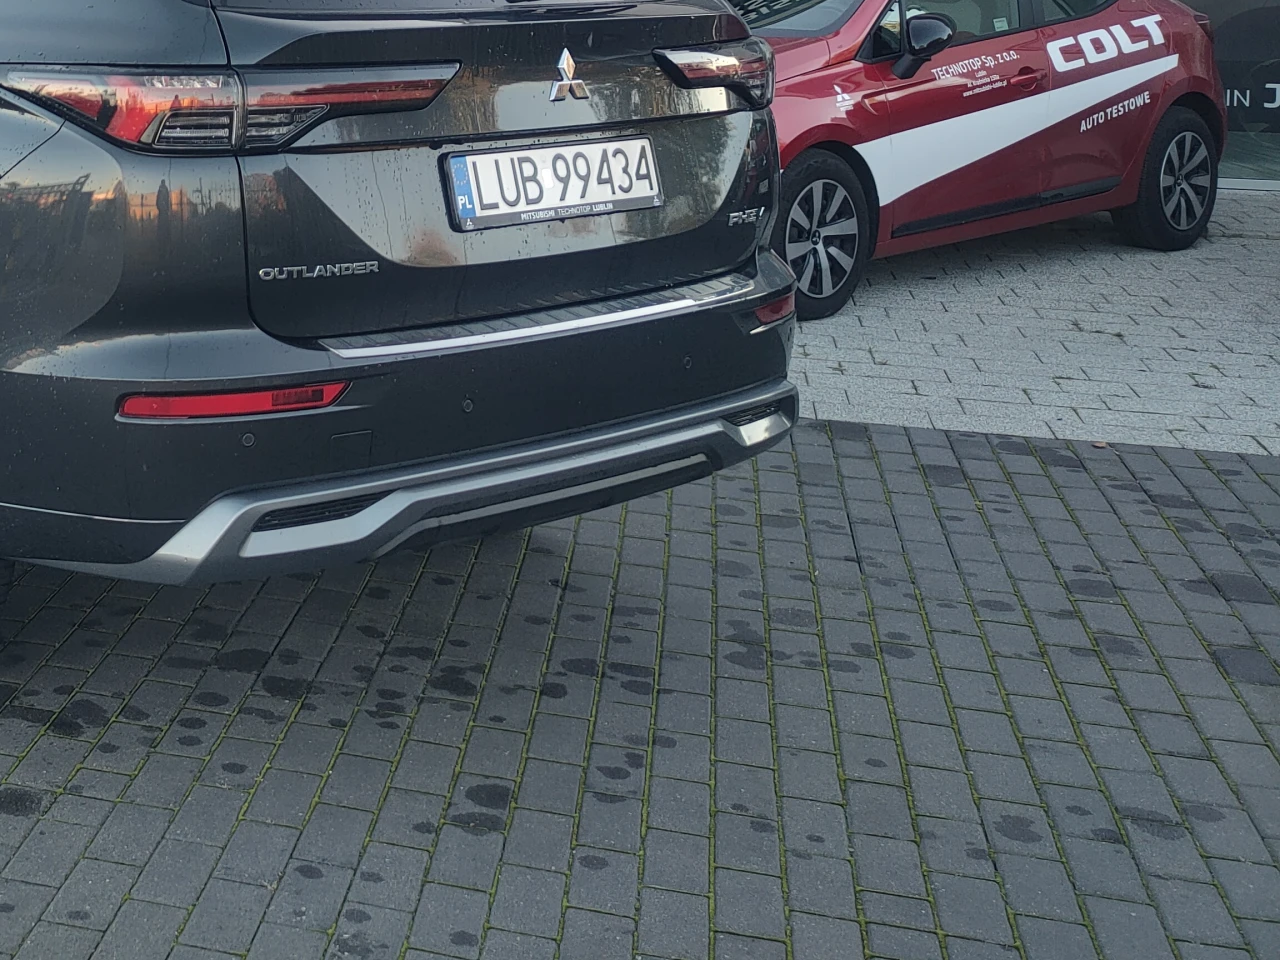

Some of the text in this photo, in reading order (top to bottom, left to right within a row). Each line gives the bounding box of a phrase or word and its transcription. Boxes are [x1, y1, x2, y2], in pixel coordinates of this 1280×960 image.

[1046, 14, 1165, 73] COLT
[931, 57, 982, 80] TECHNOTOP
[1079, 91, 1151, 133] AUTO TESTOWE
[472, 144, 654, 211] LUB 99434
[457, 195, 473, 209] PL
[520, 203, 613, 221] MITSUBISHI TECHNOTOP LUBLIN
[259, 260, 380, 280] OUTLANDER
